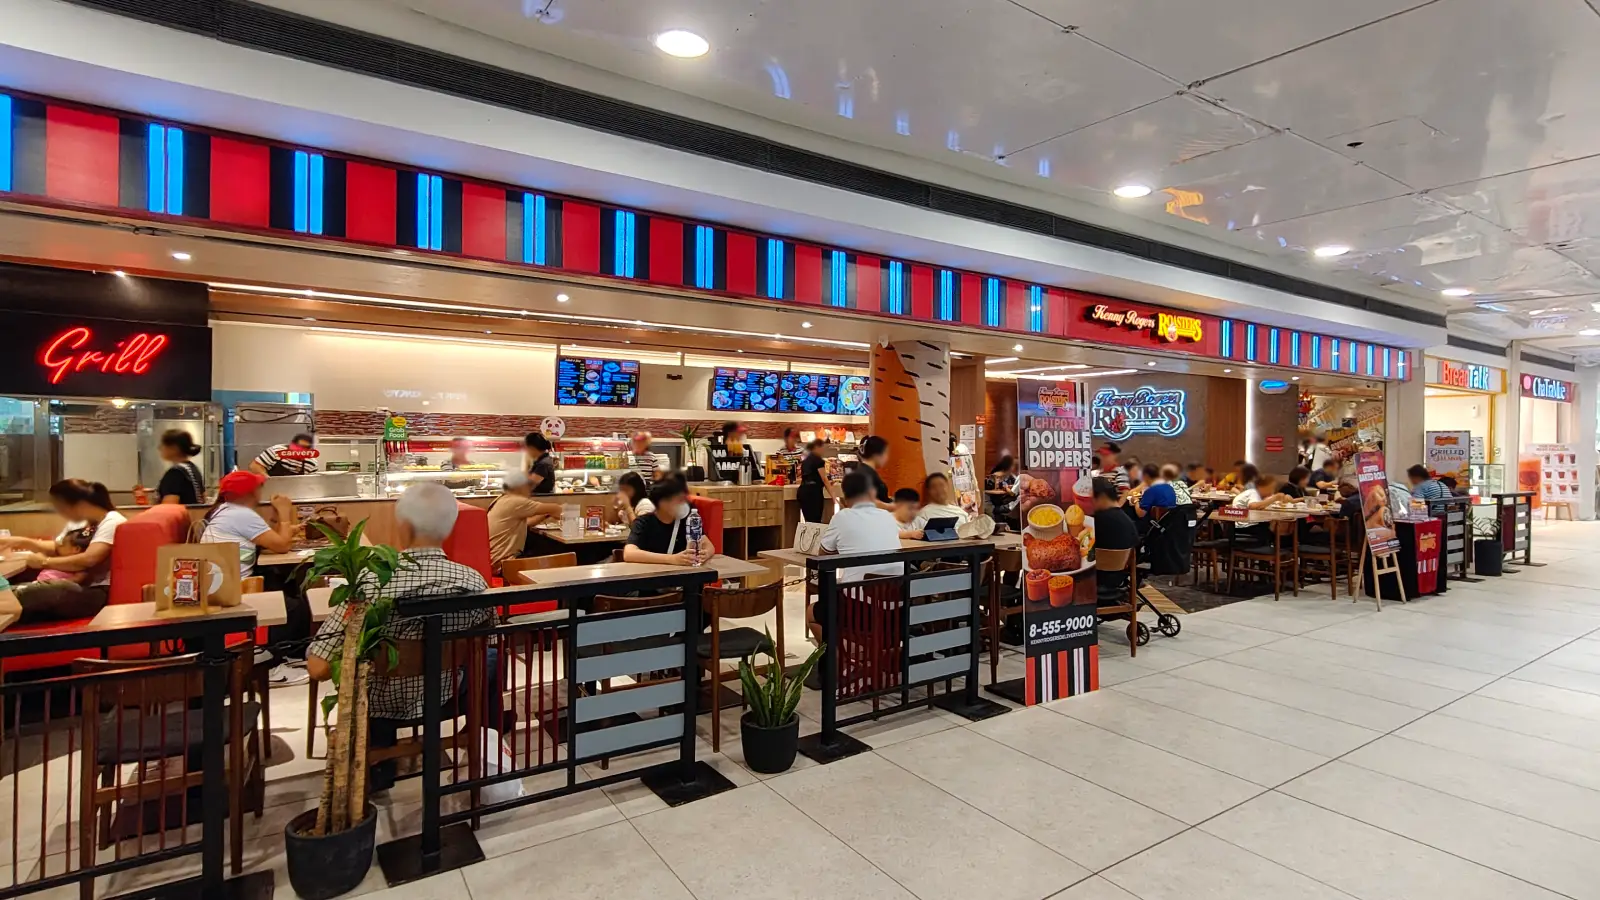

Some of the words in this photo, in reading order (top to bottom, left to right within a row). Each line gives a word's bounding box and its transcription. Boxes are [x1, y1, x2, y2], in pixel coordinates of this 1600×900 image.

[1092, 304, 1125, 326] Kenny
[1125, 310, 1155, 329] Rogers
[1158, 313, 1202, 342] ROASTERS
[43, 327, 167, 384] Grill
[1095, 389, 1136, 408] Kenny
[1135, 387, 1179, 406] Rogers
[1532, 377, 1566, 400] ChaTraMue
[1034, 417, 1086, 430] CHIPOTLE
[1093, 405, 1181, 434] ROASTERS
[1028, 430, 1091, 449] DOUBLE
[1029, 450, 1091, 468] DIPPERS
[1430, 449, 1465, 457] GRILLED
[1029, 615, 1094, 638] 8-555-9000
